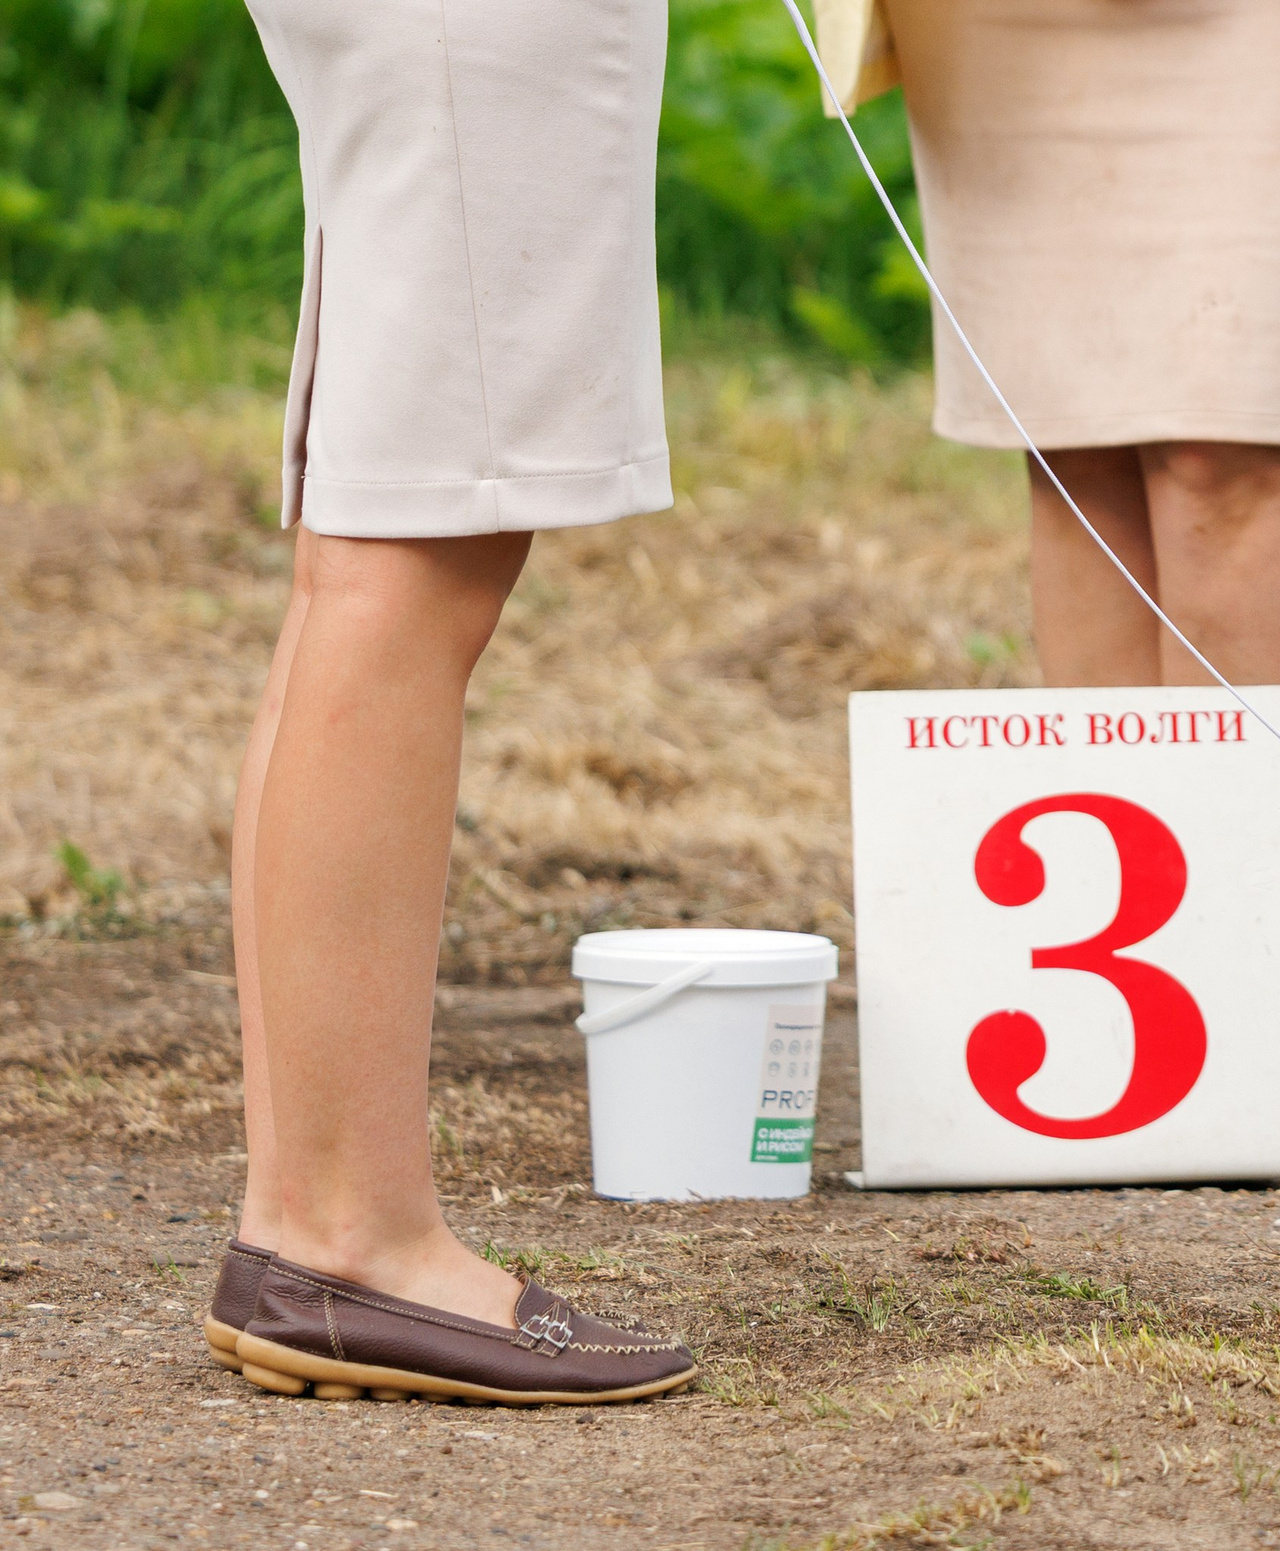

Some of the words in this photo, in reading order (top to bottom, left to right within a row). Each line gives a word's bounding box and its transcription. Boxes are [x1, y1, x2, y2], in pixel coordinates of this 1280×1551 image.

[904, 713, 1067, 749] ИСТОК
[1084, 710, 1248, 745] ВОЛГИ
[966, 792, 1208, 1140] 3
